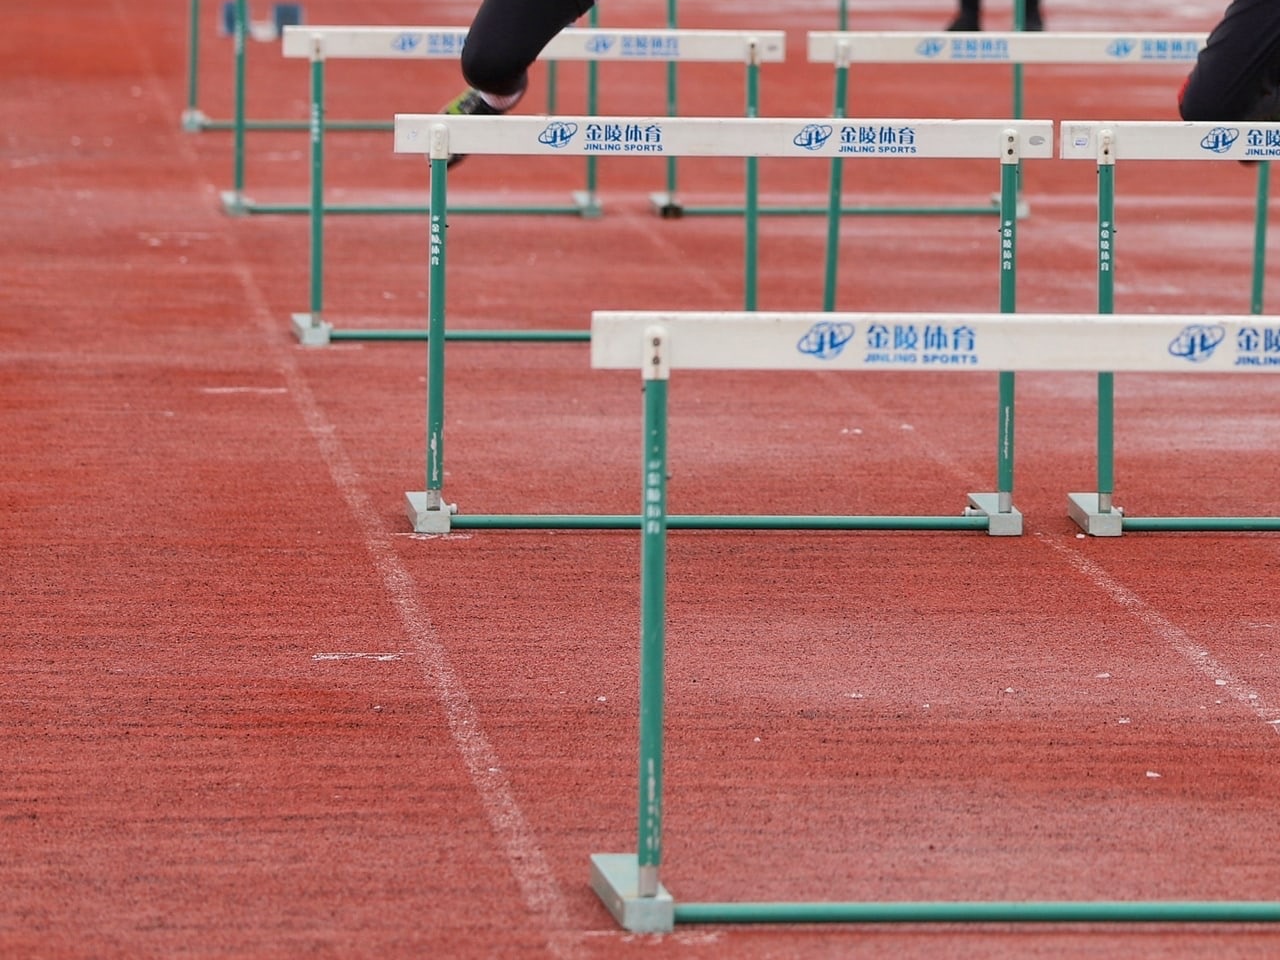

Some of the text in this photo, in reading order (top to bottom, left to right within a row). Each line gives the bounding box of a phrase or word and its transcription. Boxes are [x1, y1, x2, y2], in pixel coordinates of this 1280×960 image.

[585, 124, 662, 143] 金陵体育
[840, 126, 916, 145] 金陵体育
[584, 143, 664, 152] JINLING SPORTS
[838, 145, 917, 154] JINLING SPORTS
[866, 324, 976, 351] 金陵体育
[864, 353, 979, 364] JINLING SPORTS
